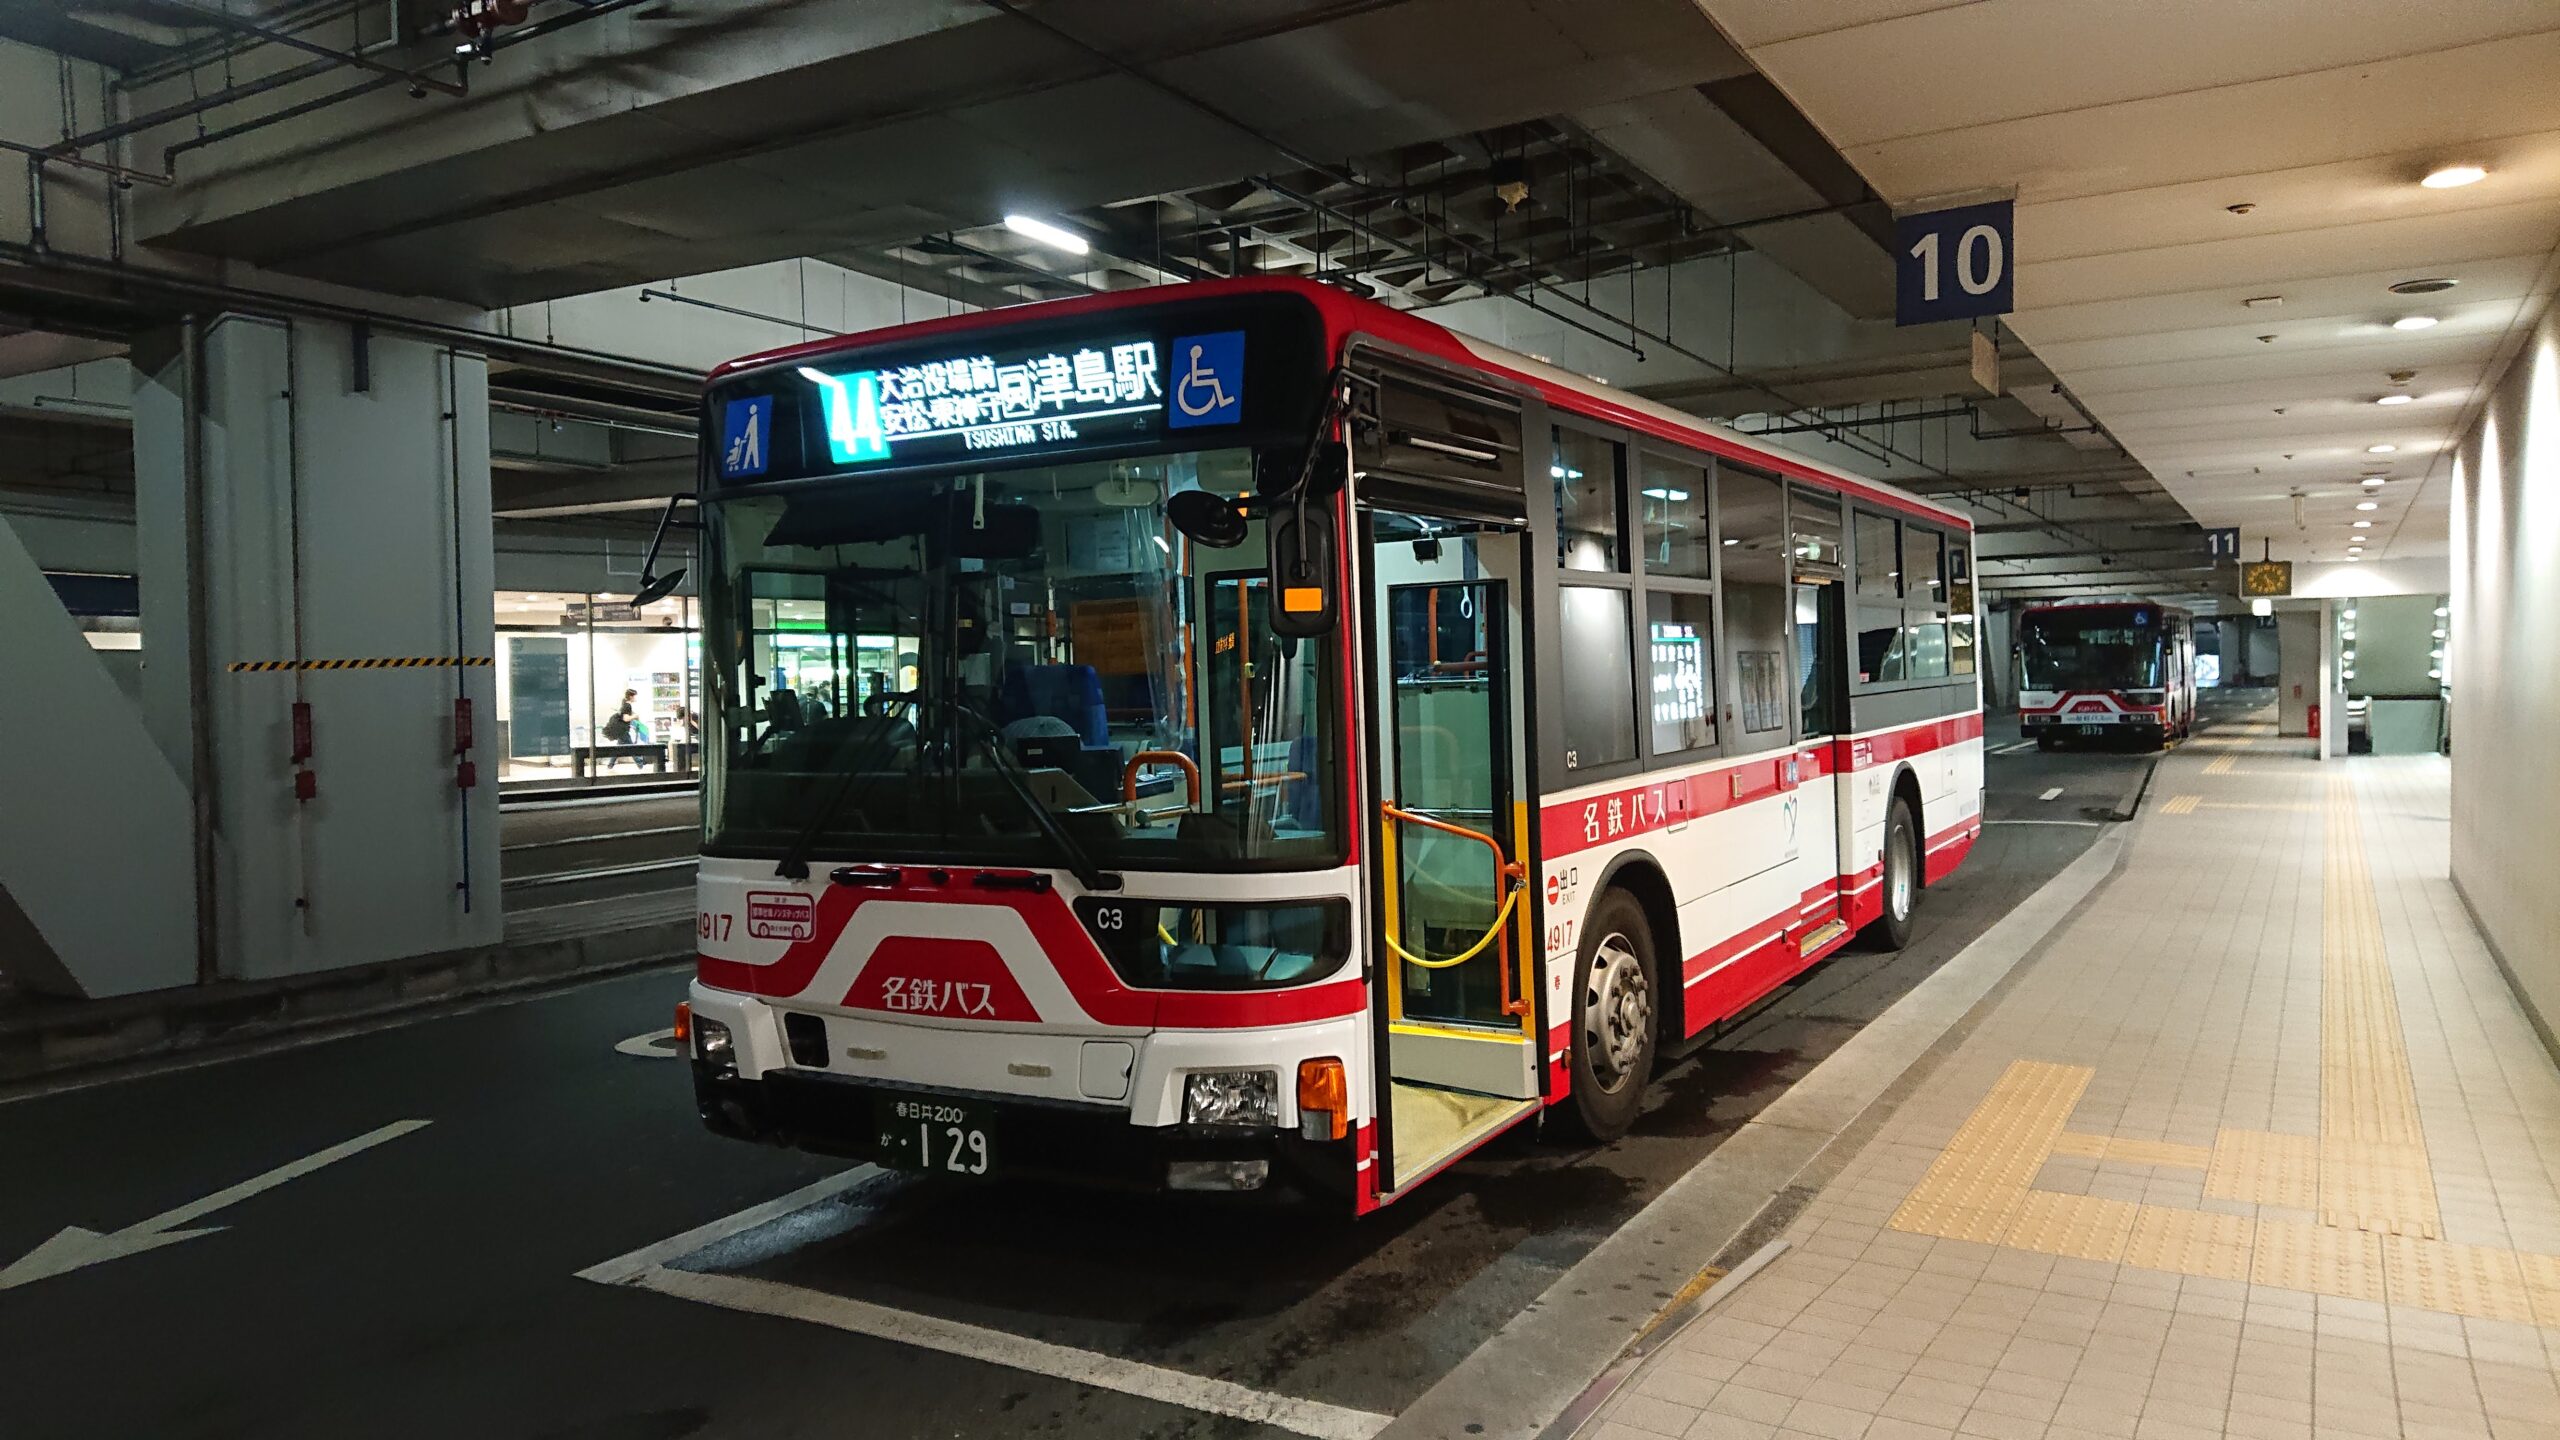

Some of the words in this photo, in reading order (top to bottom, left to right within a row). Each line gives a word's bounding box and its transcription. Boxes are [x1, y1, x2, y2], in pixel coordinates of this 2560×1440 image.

[1910, 224, 2003, 301] 10
[876, 355, 998, 402] 大治役場前
[1027, 341, 1163, 411] 津島駅
[832, 377, 882, 455] 44
[962, 422, 1036, 450] TSUSHIMA
[2208, 532, 2234, 555] 11
[1566, 751, 1577, 768] C3
[1583, 790, 1667, 843] 名鉄バス
[1559, 867, 1578, 891] 出口
[1562, 890, 1575, 905] EXIT
[1097, 907, 1123, 930] C3
[1547, 920, 1573, 952] 4917
[882, 976, 995, 1016] 名鉄バス
[881, 1132, 892, 1147] か
